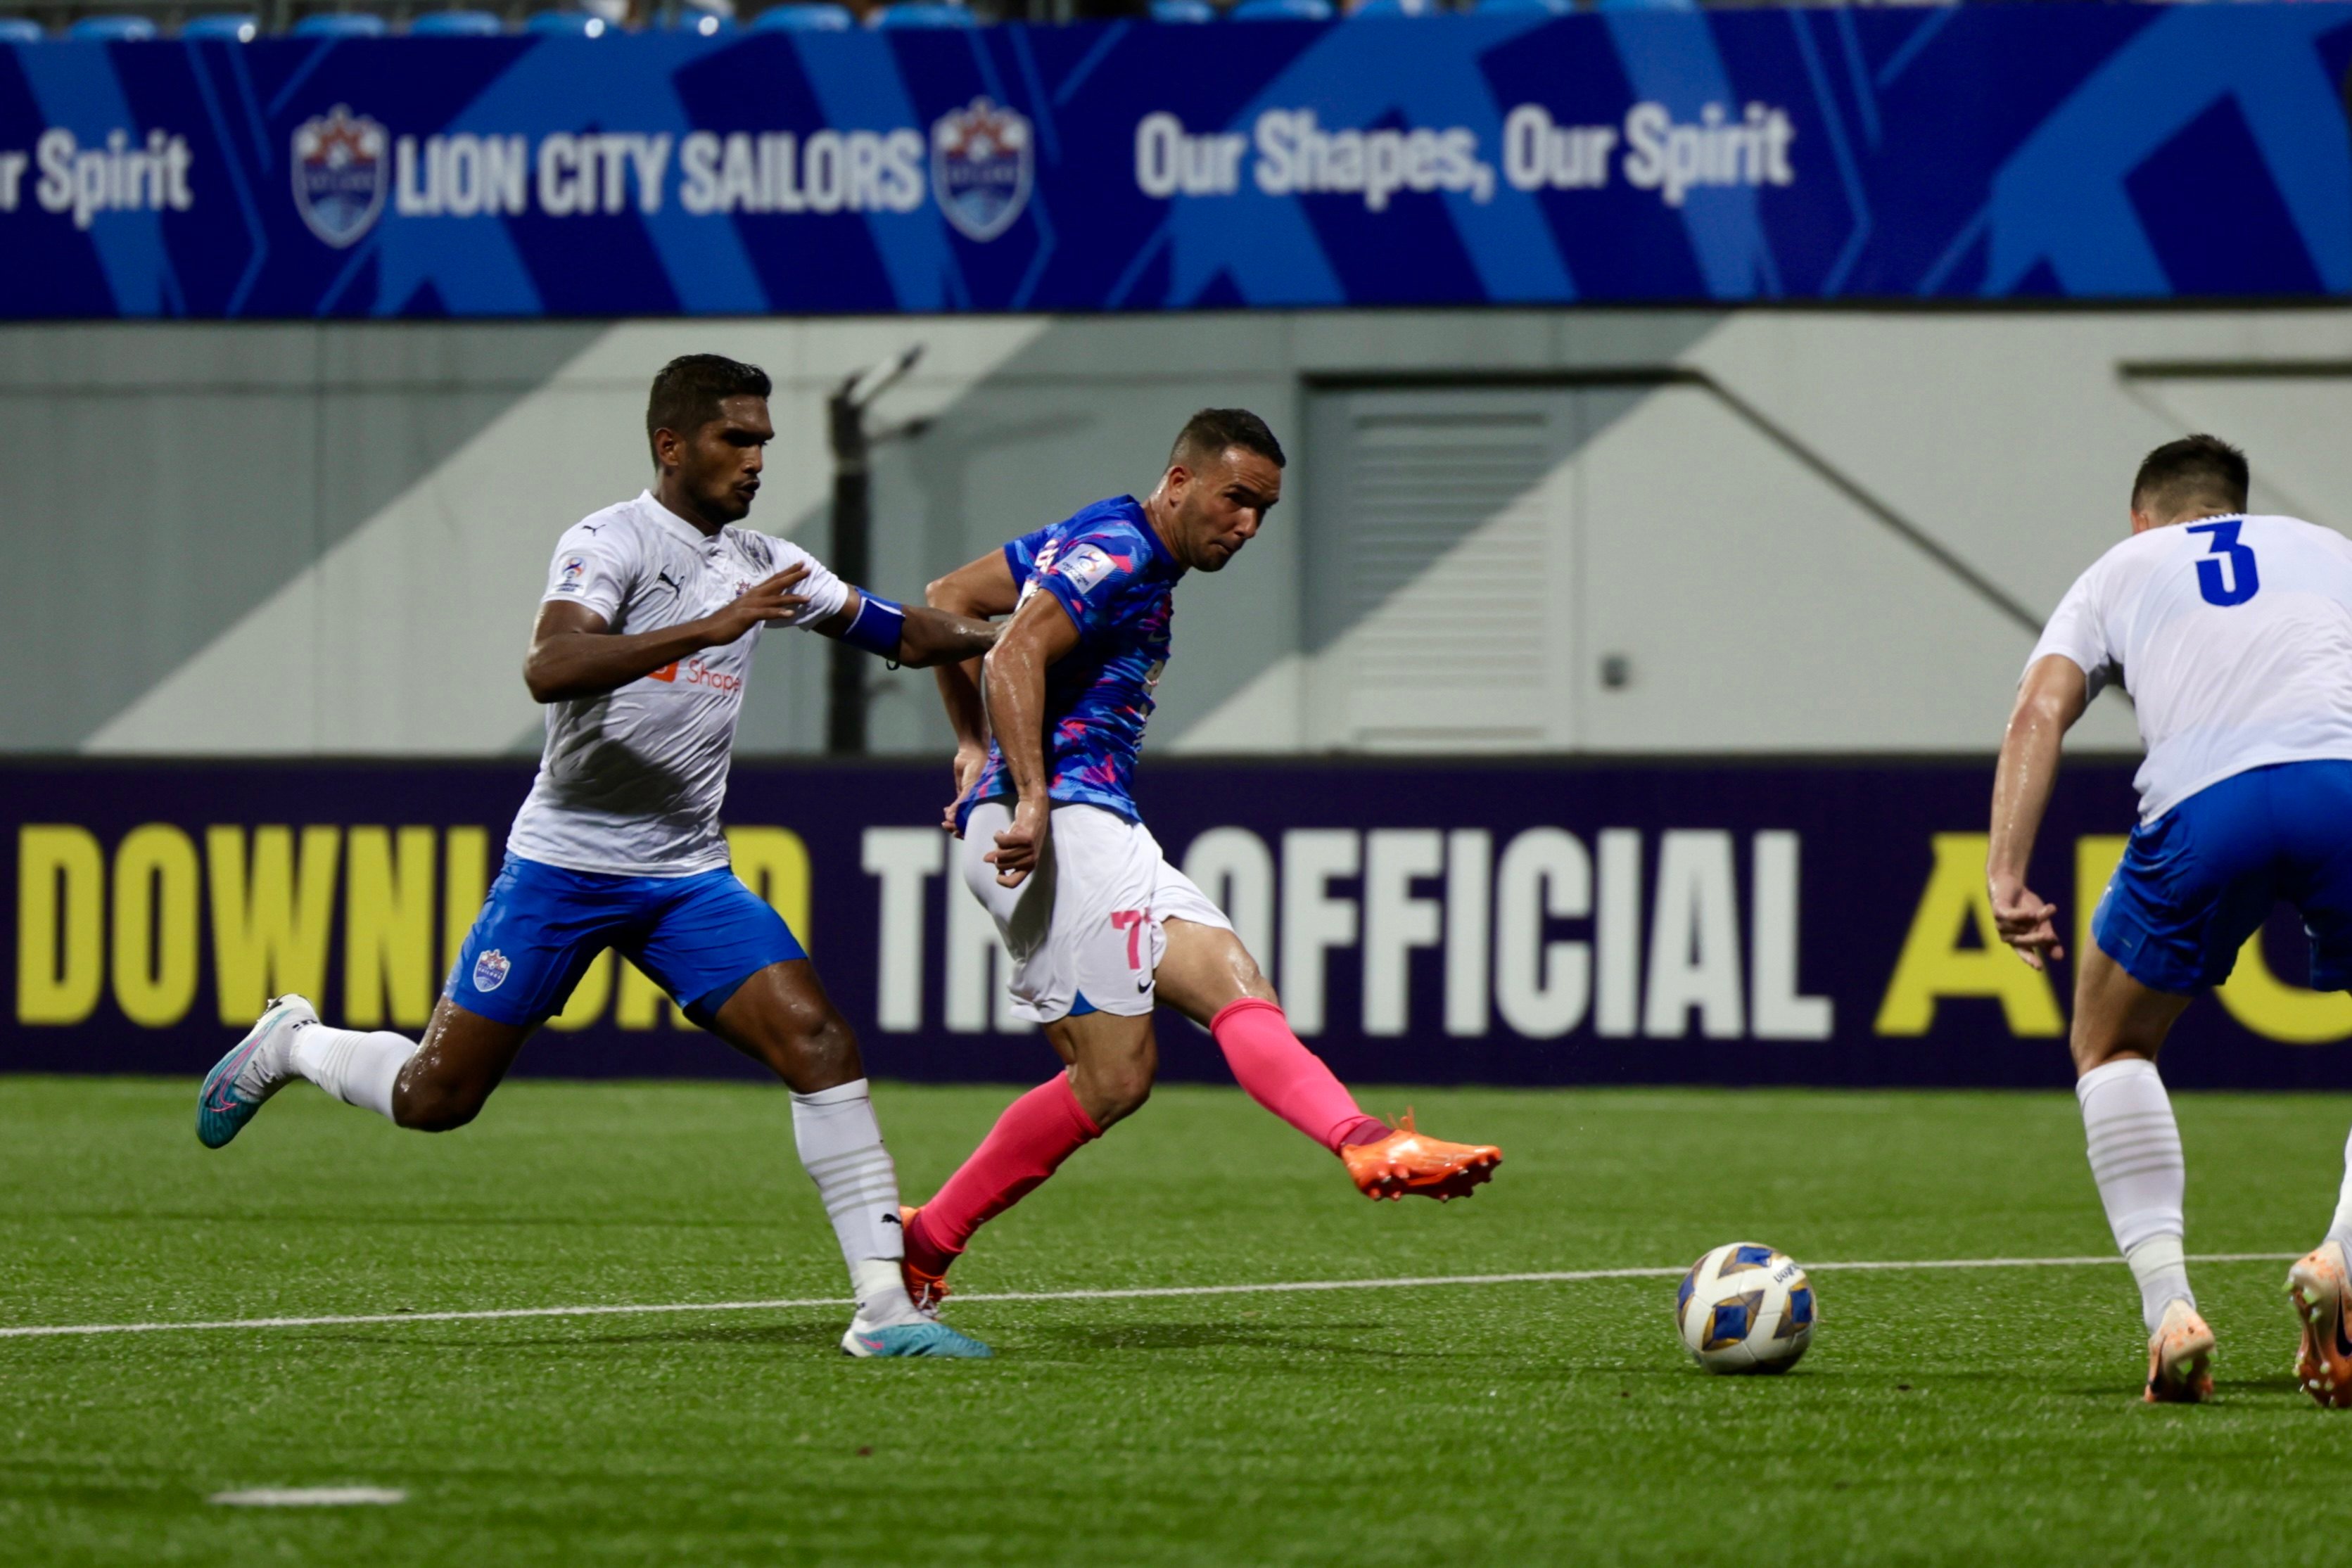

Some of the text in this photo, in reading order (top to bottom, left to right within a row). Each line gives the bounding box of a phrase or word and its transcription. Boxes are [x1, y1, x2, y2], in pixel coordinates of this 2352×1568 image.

[37, 129, 191, 229] Spirit
[396, 129, 925, 217] LION CITY SAILORS
[1136, 102, 1791, 210] Our Shapes, Our Spirit
[2185, 520, 2259, 607] 3
